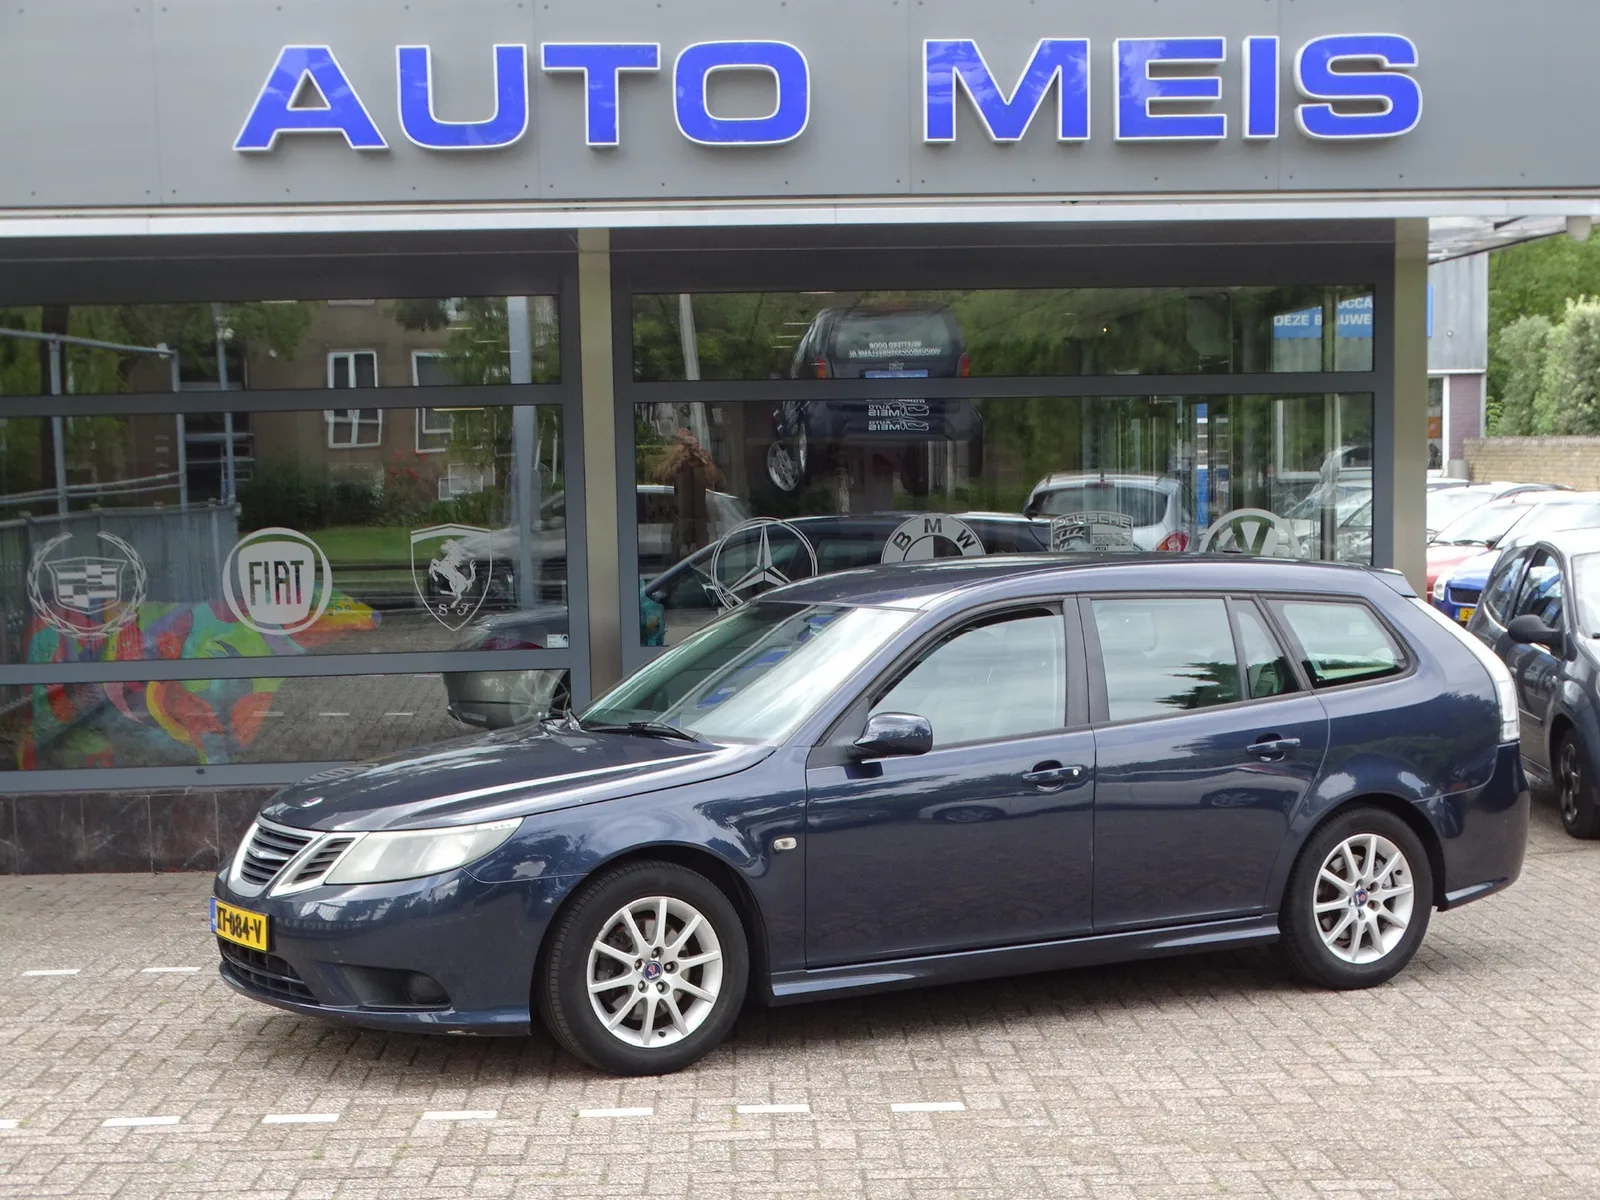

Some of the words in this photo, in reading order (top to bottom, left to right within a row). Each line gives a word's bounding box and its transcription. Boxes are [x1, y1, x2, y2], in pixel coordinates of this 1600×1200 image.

[232, 39, 811, 152] AUTO
[922, 32, 1422, 144] MEIS
[1273, 314, 1309, 326] DEZE
[1314, 313, 1372, 325] BUWE
[892, 518, 977, 551] BMW
[1053, 513, 1131, 531] PORSCHE
[249, 559, 305, 606] FIAT
